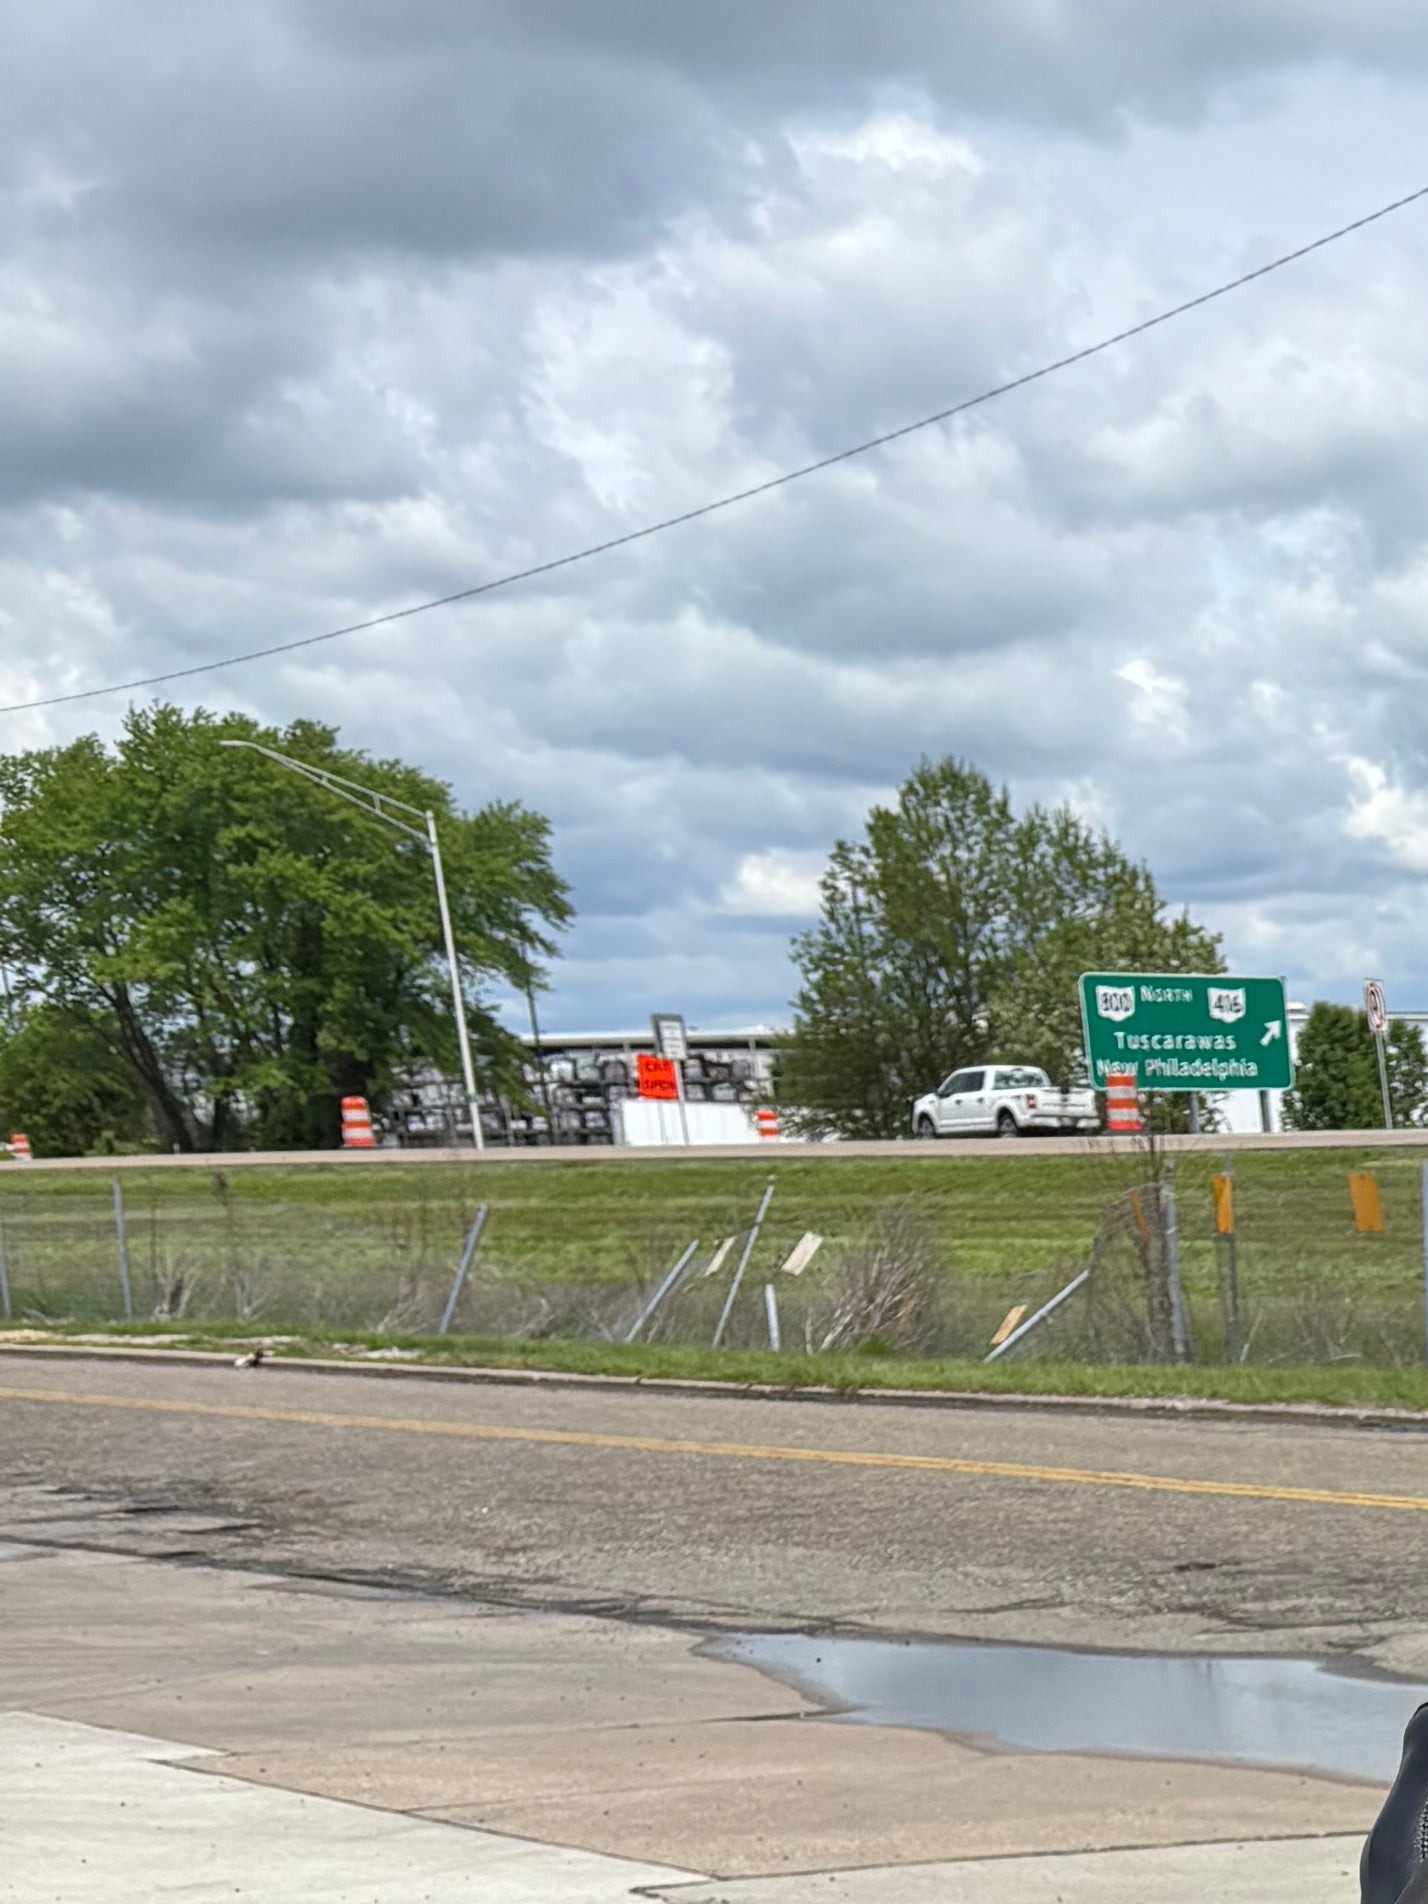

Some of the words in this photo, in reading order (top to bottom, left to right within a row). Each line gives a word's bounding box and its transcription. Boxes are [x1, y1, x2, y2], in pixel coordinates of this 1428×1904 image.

[1214, 994, 1244, 1014] 416
[1113, 1031, 1237, 1051] Tuscarawas
[1096, 1058, 1138, 1077] New
[1144, 1057, 1258, 1081] Philadelphia
